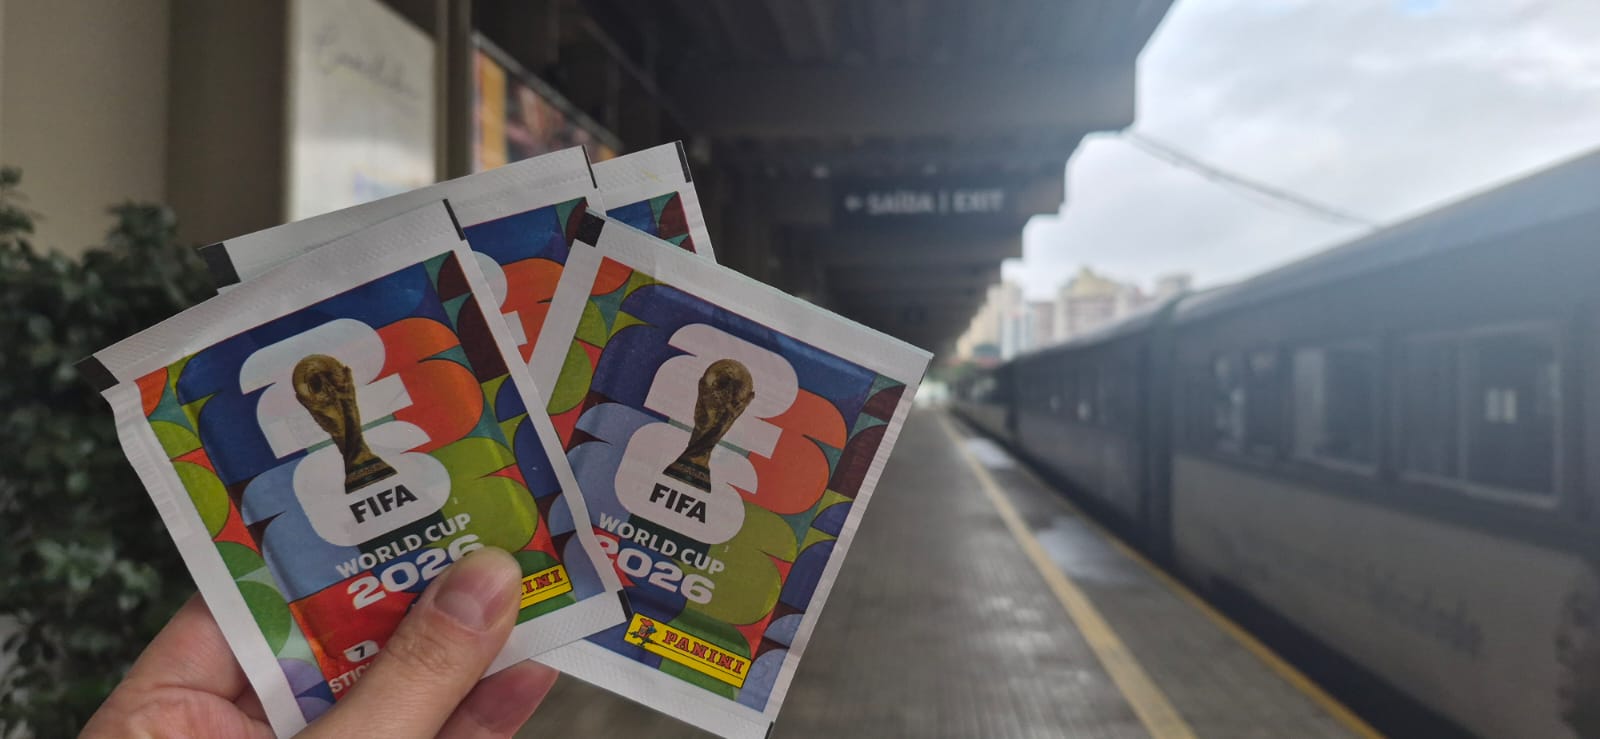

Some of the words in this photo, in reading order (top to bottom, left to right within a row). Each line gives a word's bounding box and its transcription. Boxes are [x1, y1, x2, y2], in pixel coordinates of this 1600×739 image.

[952, 188, 1004, 214] EXIT
[349, 484, 418, 524] FIFA
[649, 483, 706, 524] FIFA
[335, 534, 422, 579] WORLD
[424, 512, 471, 542] CUP
[600, 512, 678, 557] WORLD
[680, 548, 725, 575] CUP
[521, 569, 562, 596] INI
[354, 645, 366, 659] 7
[662, 629, 745, 675] PANINI
